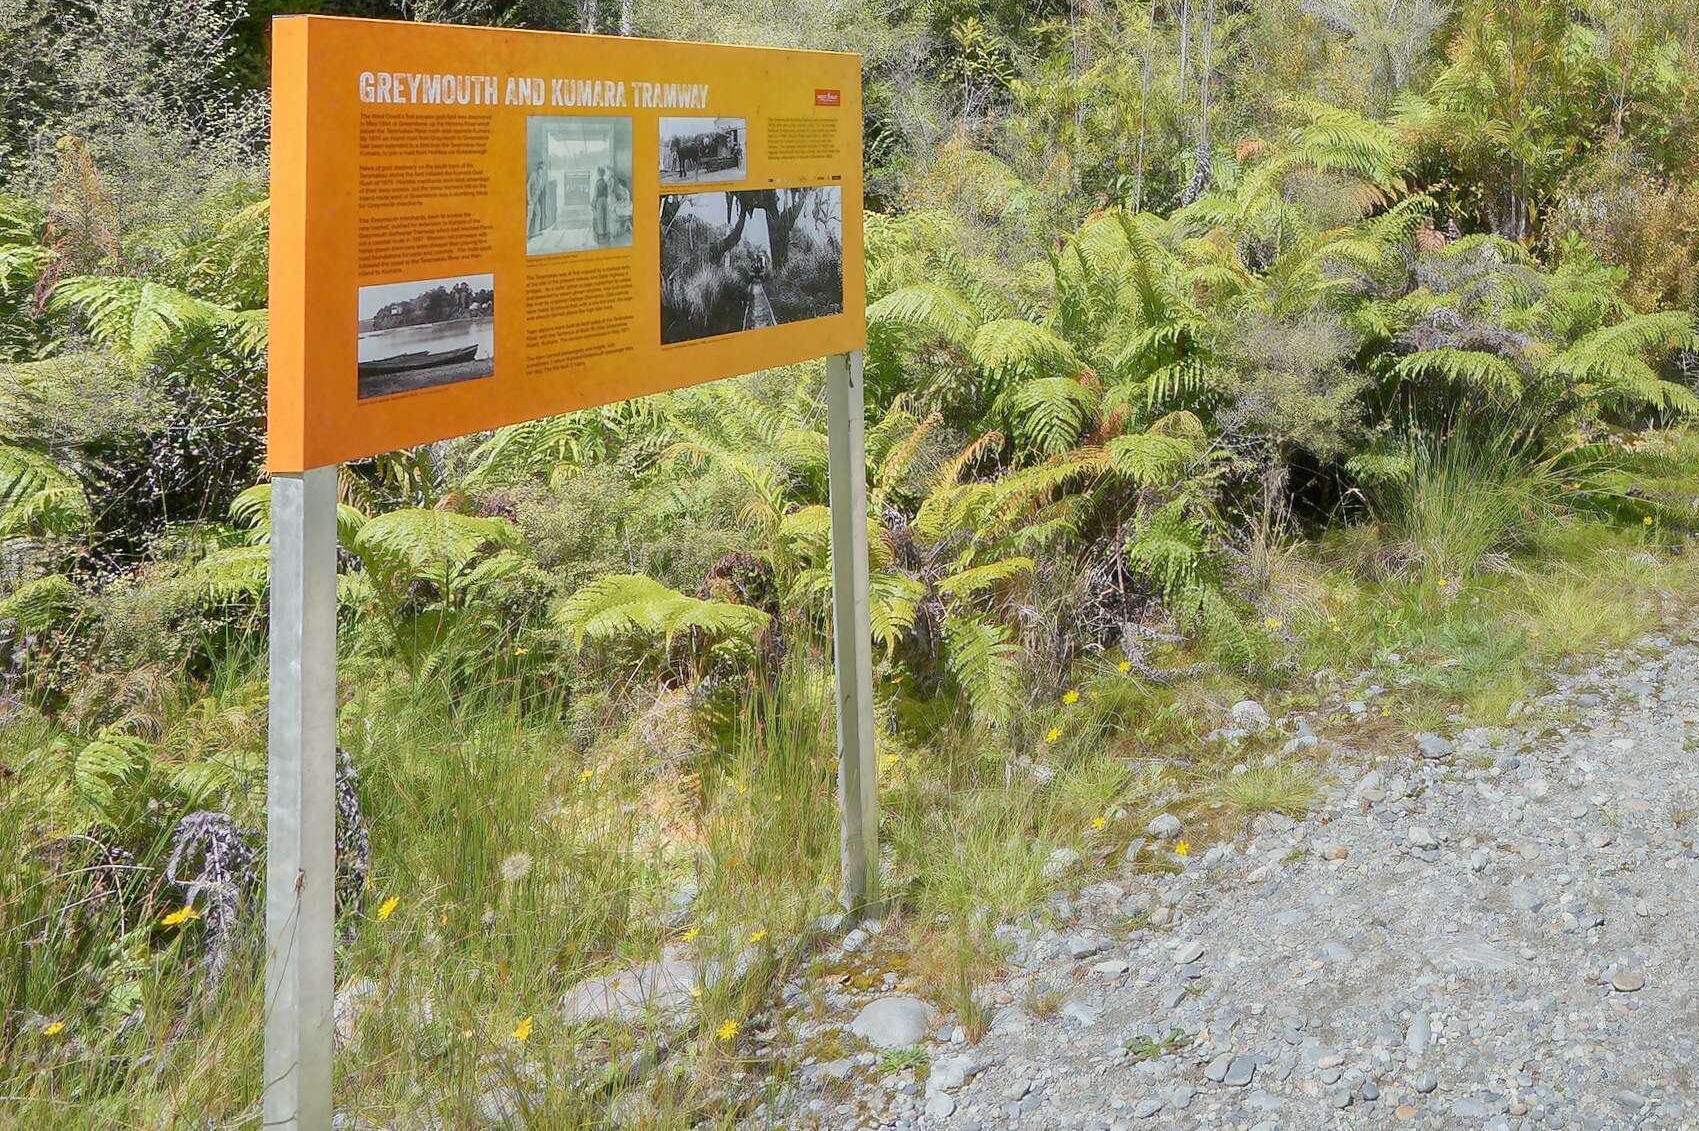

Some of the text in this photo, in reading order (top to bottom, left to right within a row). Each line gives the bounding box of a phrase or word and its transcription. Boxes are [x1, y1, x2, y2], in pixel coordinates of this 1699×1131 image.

[359, 71, 709, 109] GREYMOUTH AND KUMARA TRAMWAY
